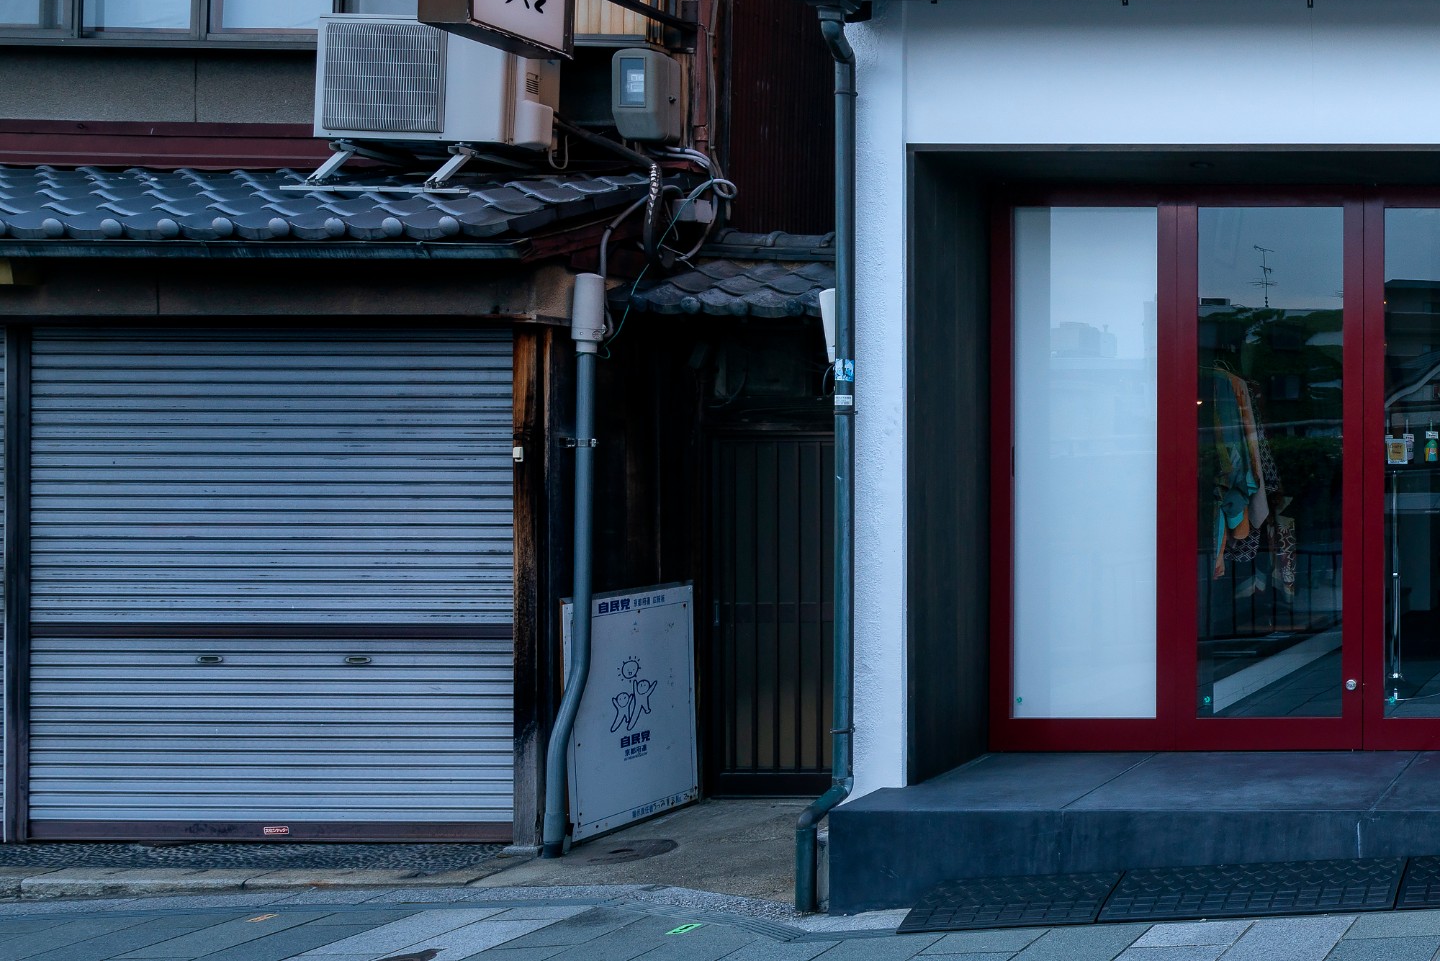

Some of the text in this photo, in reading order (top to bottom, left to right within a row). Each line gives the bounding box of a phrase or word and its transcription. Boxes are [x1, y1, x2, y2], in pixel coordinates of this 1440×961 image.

[598, 598, 631, 614] 自民党
[620, 730, 651, 748] 自民党
